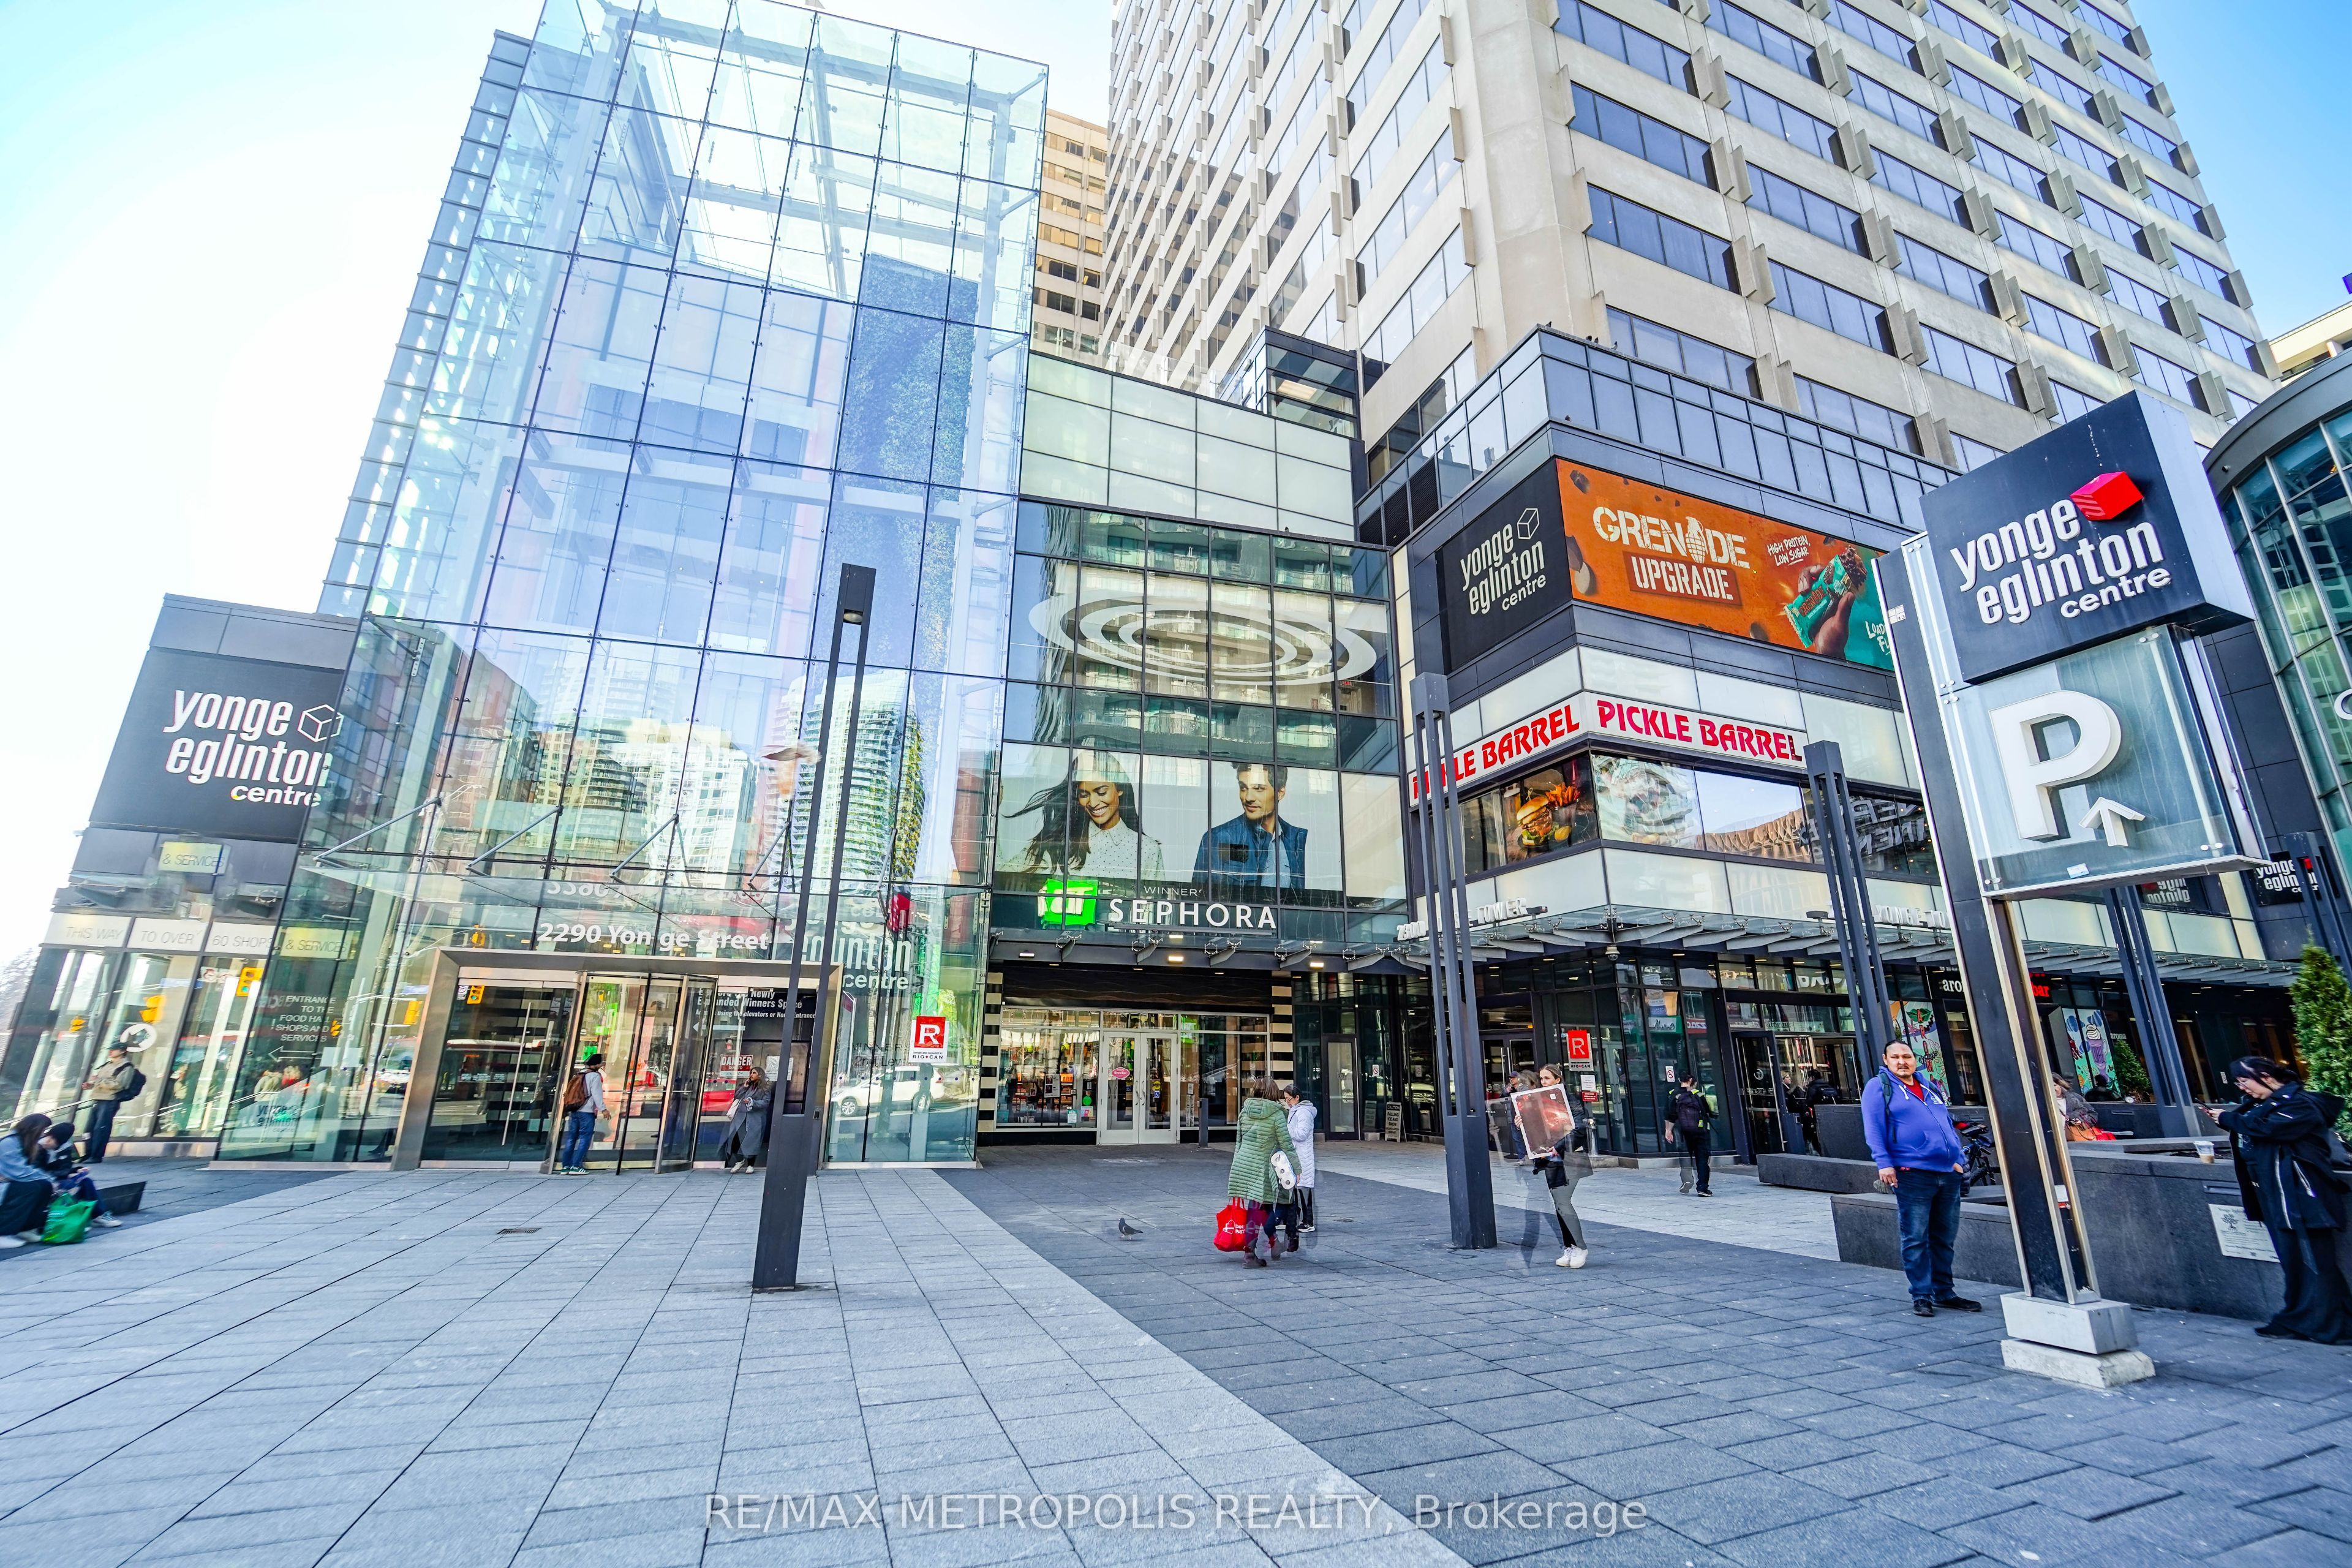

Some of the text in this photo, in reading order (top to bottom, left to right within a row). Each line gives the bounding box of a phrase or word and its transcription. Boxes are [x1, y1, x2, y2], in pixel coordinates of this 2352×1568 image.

[1767, 535, 1811, 556] HIGH PROTEIN,
[1950, 499, 2079, 592] yonge
[1460, 522, 1514, 591] yonge
[1774, 548, 1809, 566] LOW SUGAR
[1469, 541, 1545, 614] eglinton
[1631, 556, 1733, 600] UPGRADE
[1976, 521, 2164, 624] eglinton
[1502, 575, 1547, 611] centre
[2060, 568, 2171, 618] centre
[1865, 621, 1886, 639] LOAD
[163, 690, 294, 741] yonge
[1597, 699, 1802, 762] PICKLE BARREL
[165, 734, 333, 787] eglinton
[1412, 704, 1580, 799] PIKLE BARREL
[1989, 690, 2122, 842] P
[230, 785, 321, 807] centre
[1109, 899, 1276, 929] SEPHORA
[1476, 897, 1528, 924] TOWER
[1872, 905, 1924, 926] YONGE
[66, 926, 123, 940] THIS WAY
[140, 930, 195, 944] TO OVER
[212, 935, 230, 946] 60
[537, 922, 601, 943] 2290
[696, 929, 771, 950] Street
[285, 939, 347, 953] & SERVICES
[843, 973, 909, 990] centre
[1942, 979, 1963, 992] aro
[742, 998, 775, 1008] Winners
[778, 998, 802, 1010] Spe
[751, 990, 775, 1000] Newly
[276, 1024, 309, 1033] SHOPS
[919, 1024, 941, 1045] R
[1572, 1037, 1586, 1055] R
[721, 1056, 752, 1066] DANGER
